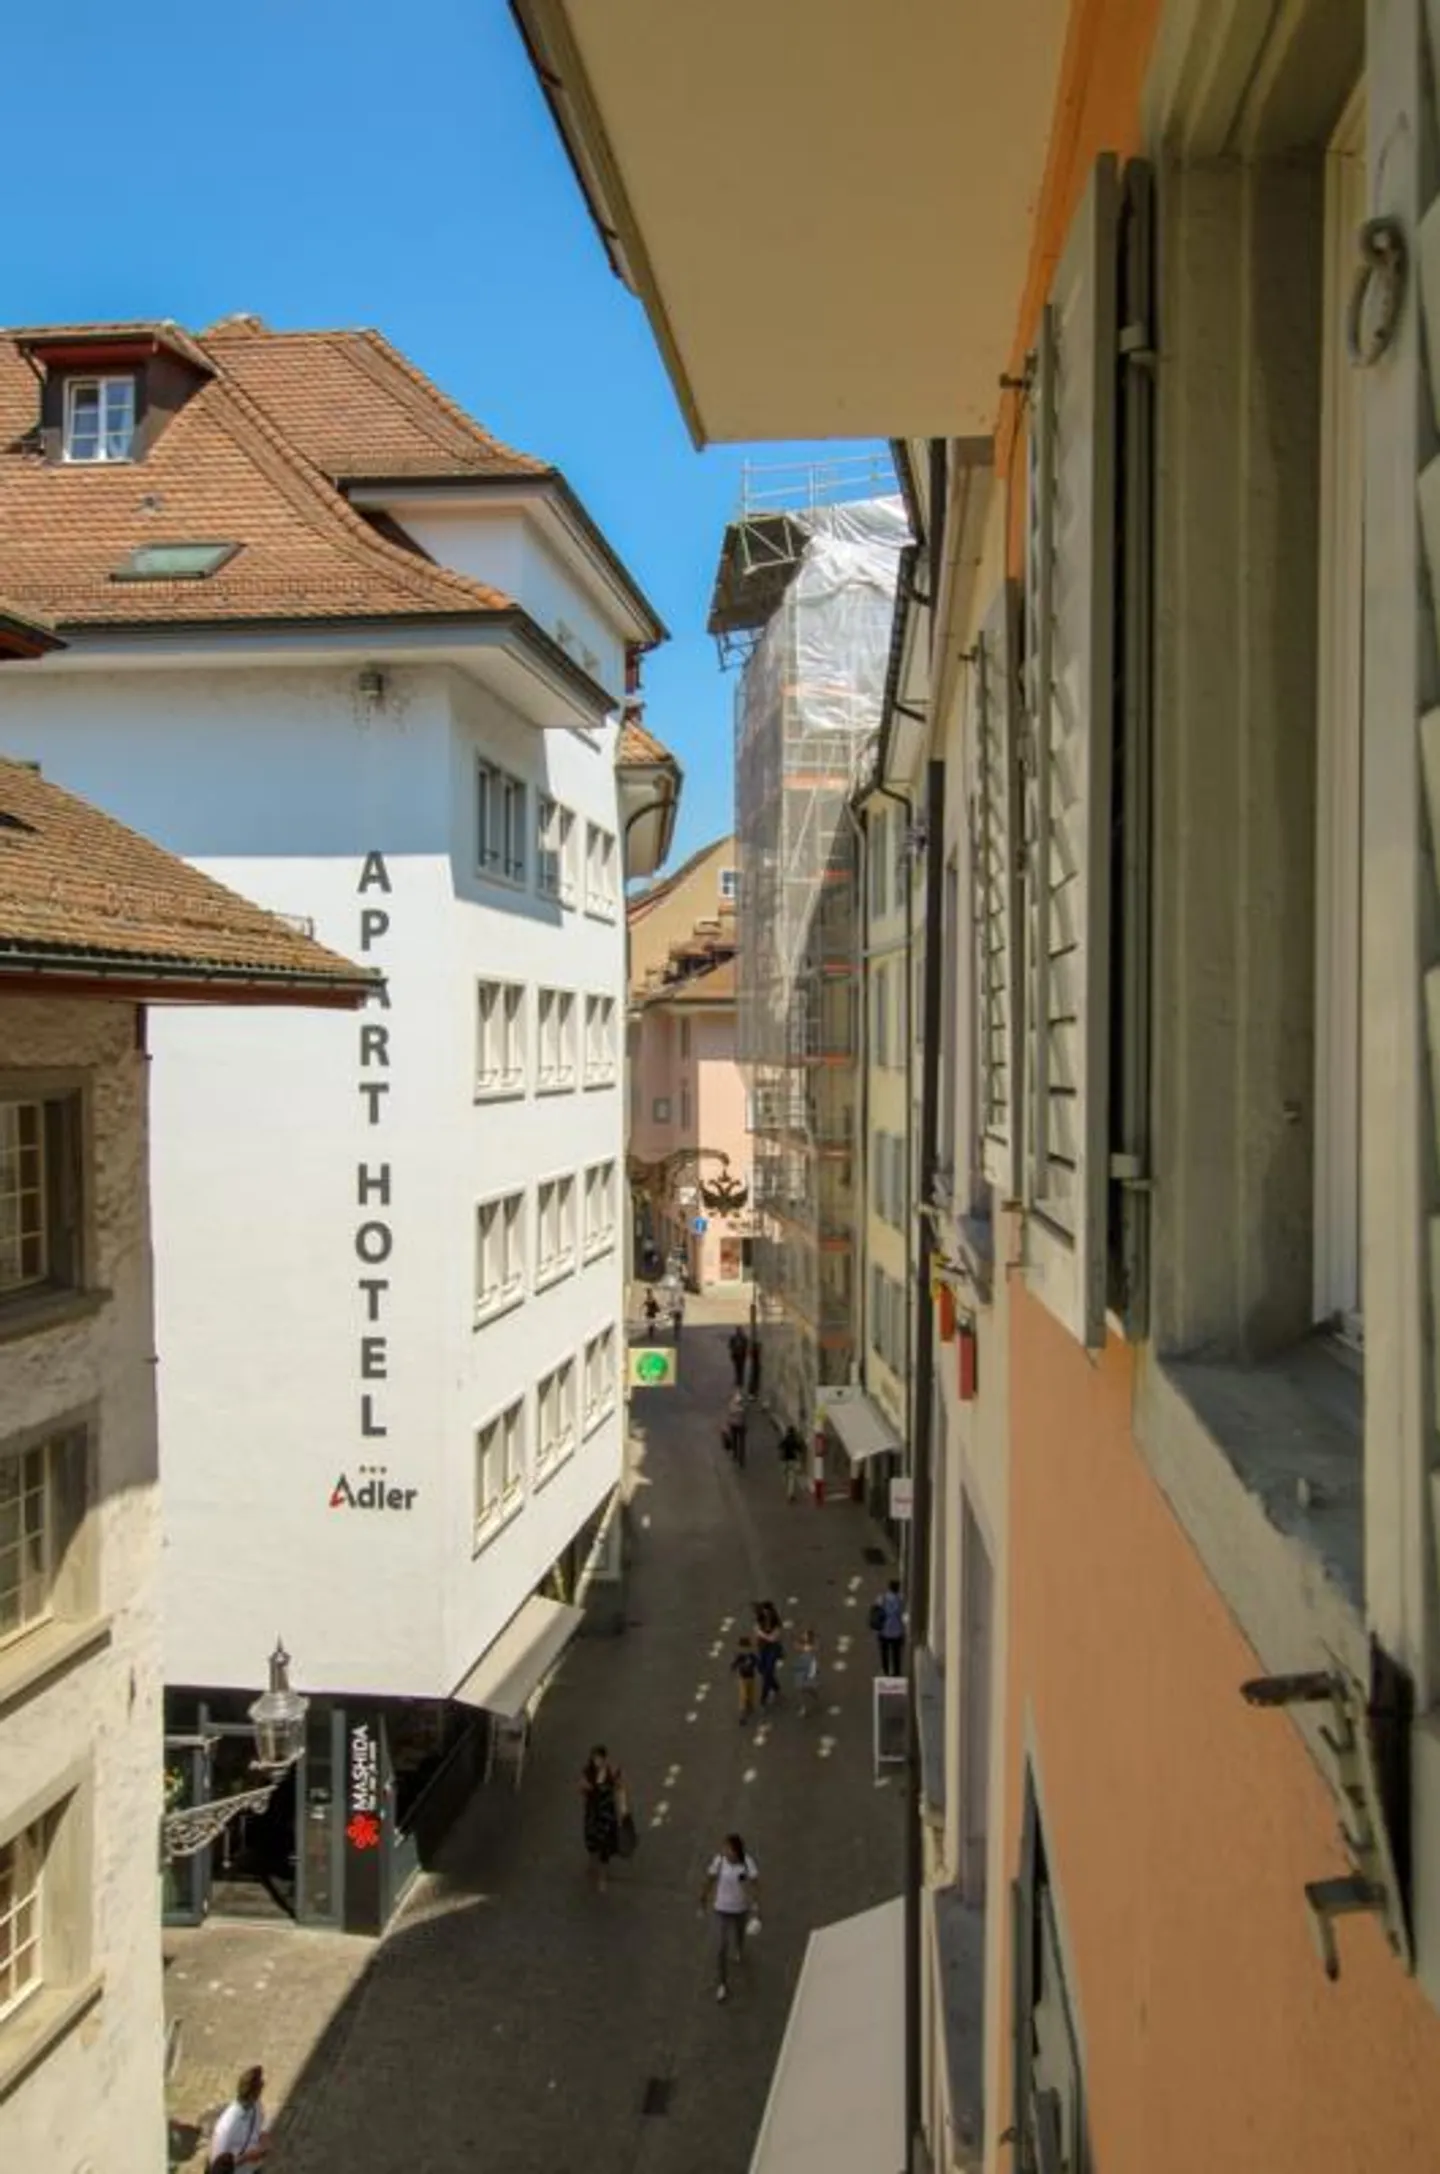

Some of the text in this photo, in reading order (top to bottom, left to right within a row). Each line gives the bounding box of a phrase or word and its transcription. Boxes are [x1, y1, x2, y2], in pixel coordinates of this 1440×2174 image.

[355, 1163, 393, 1436] HOTEL
[329, 1473, 418, 1510] Adler
[352, 1723, 368, 1811] MASHIDA
